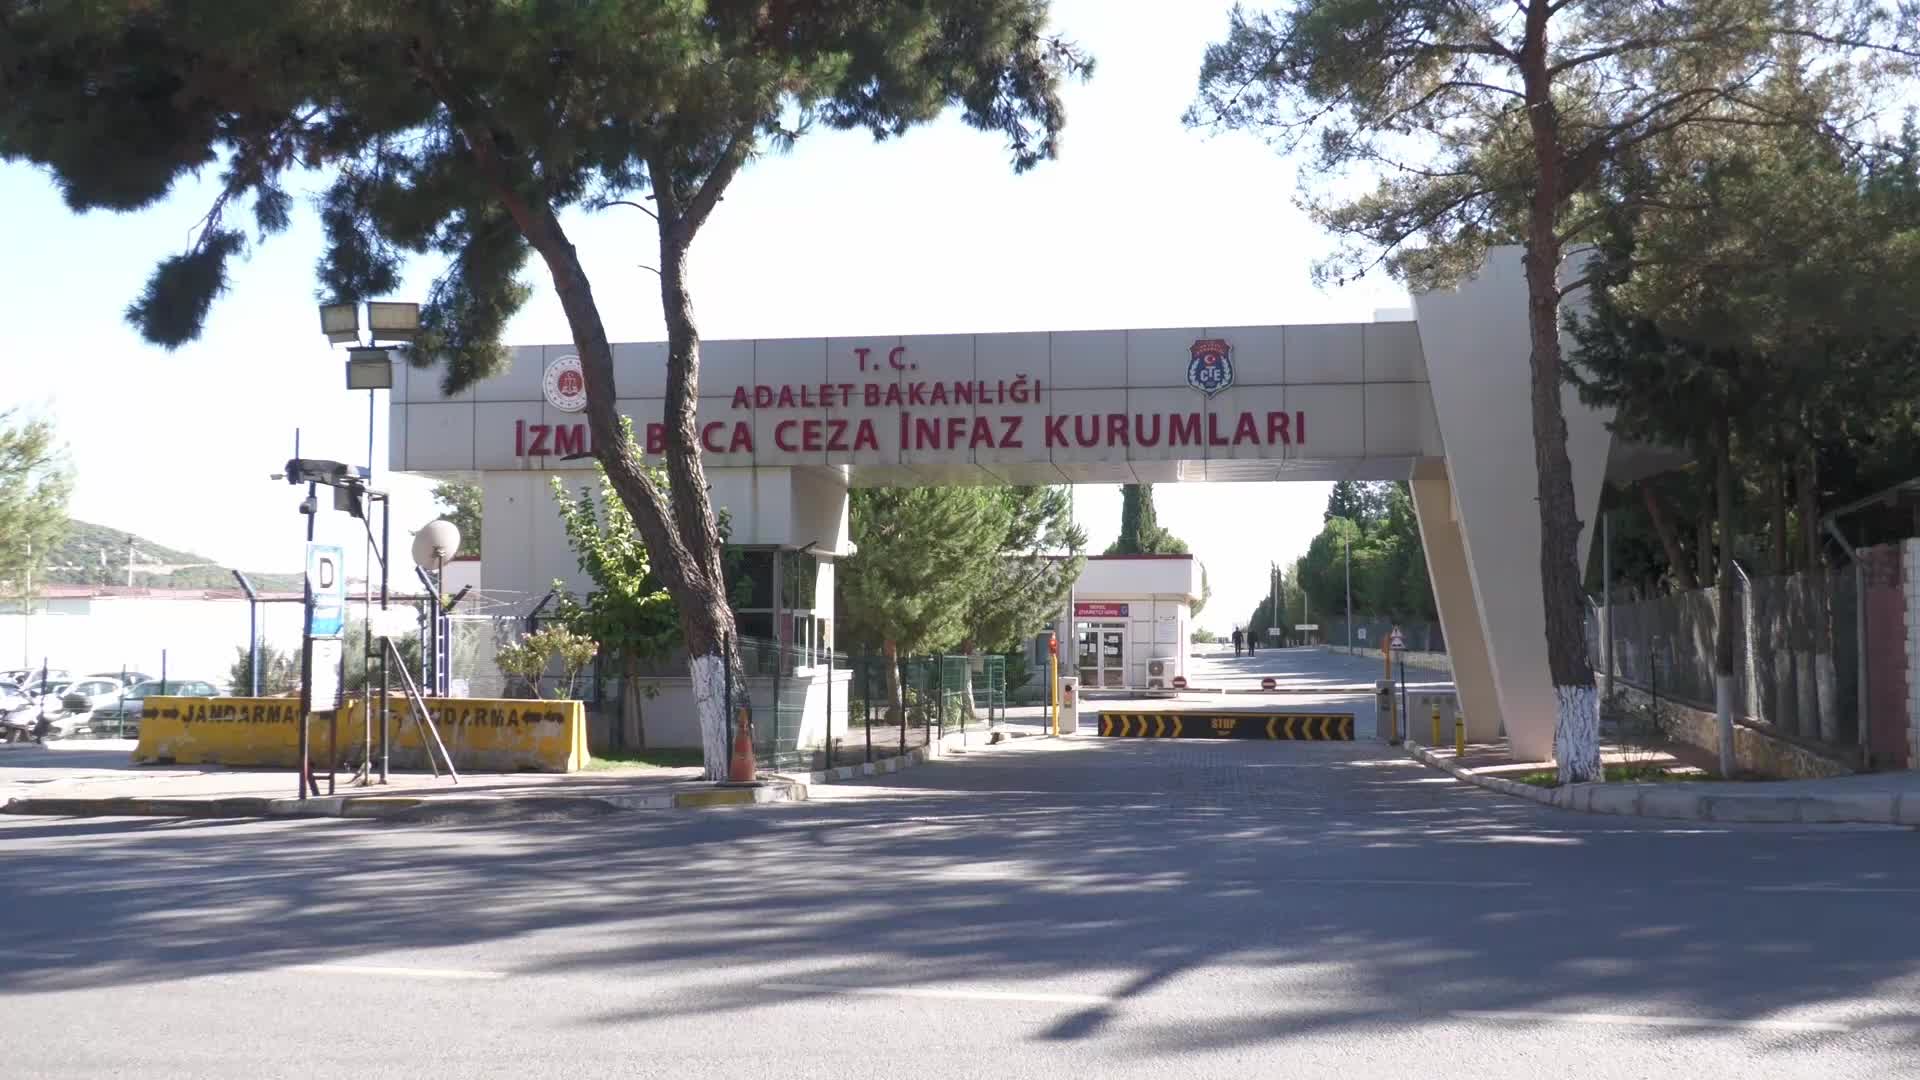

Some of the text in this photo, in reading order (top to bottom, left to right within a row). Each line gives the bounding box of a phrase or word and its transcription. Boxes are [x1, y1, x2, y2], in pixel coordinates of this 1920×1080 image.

[1200, 366, 1221, 382] CTE
[731, 373, 1041, 409] ADALET BAKANLIĞI
[515, 411, 1305, 457] İZM BCA CEZA İNFAZ KURUMLARI
[1211, 718, 1236, 729] STOP
